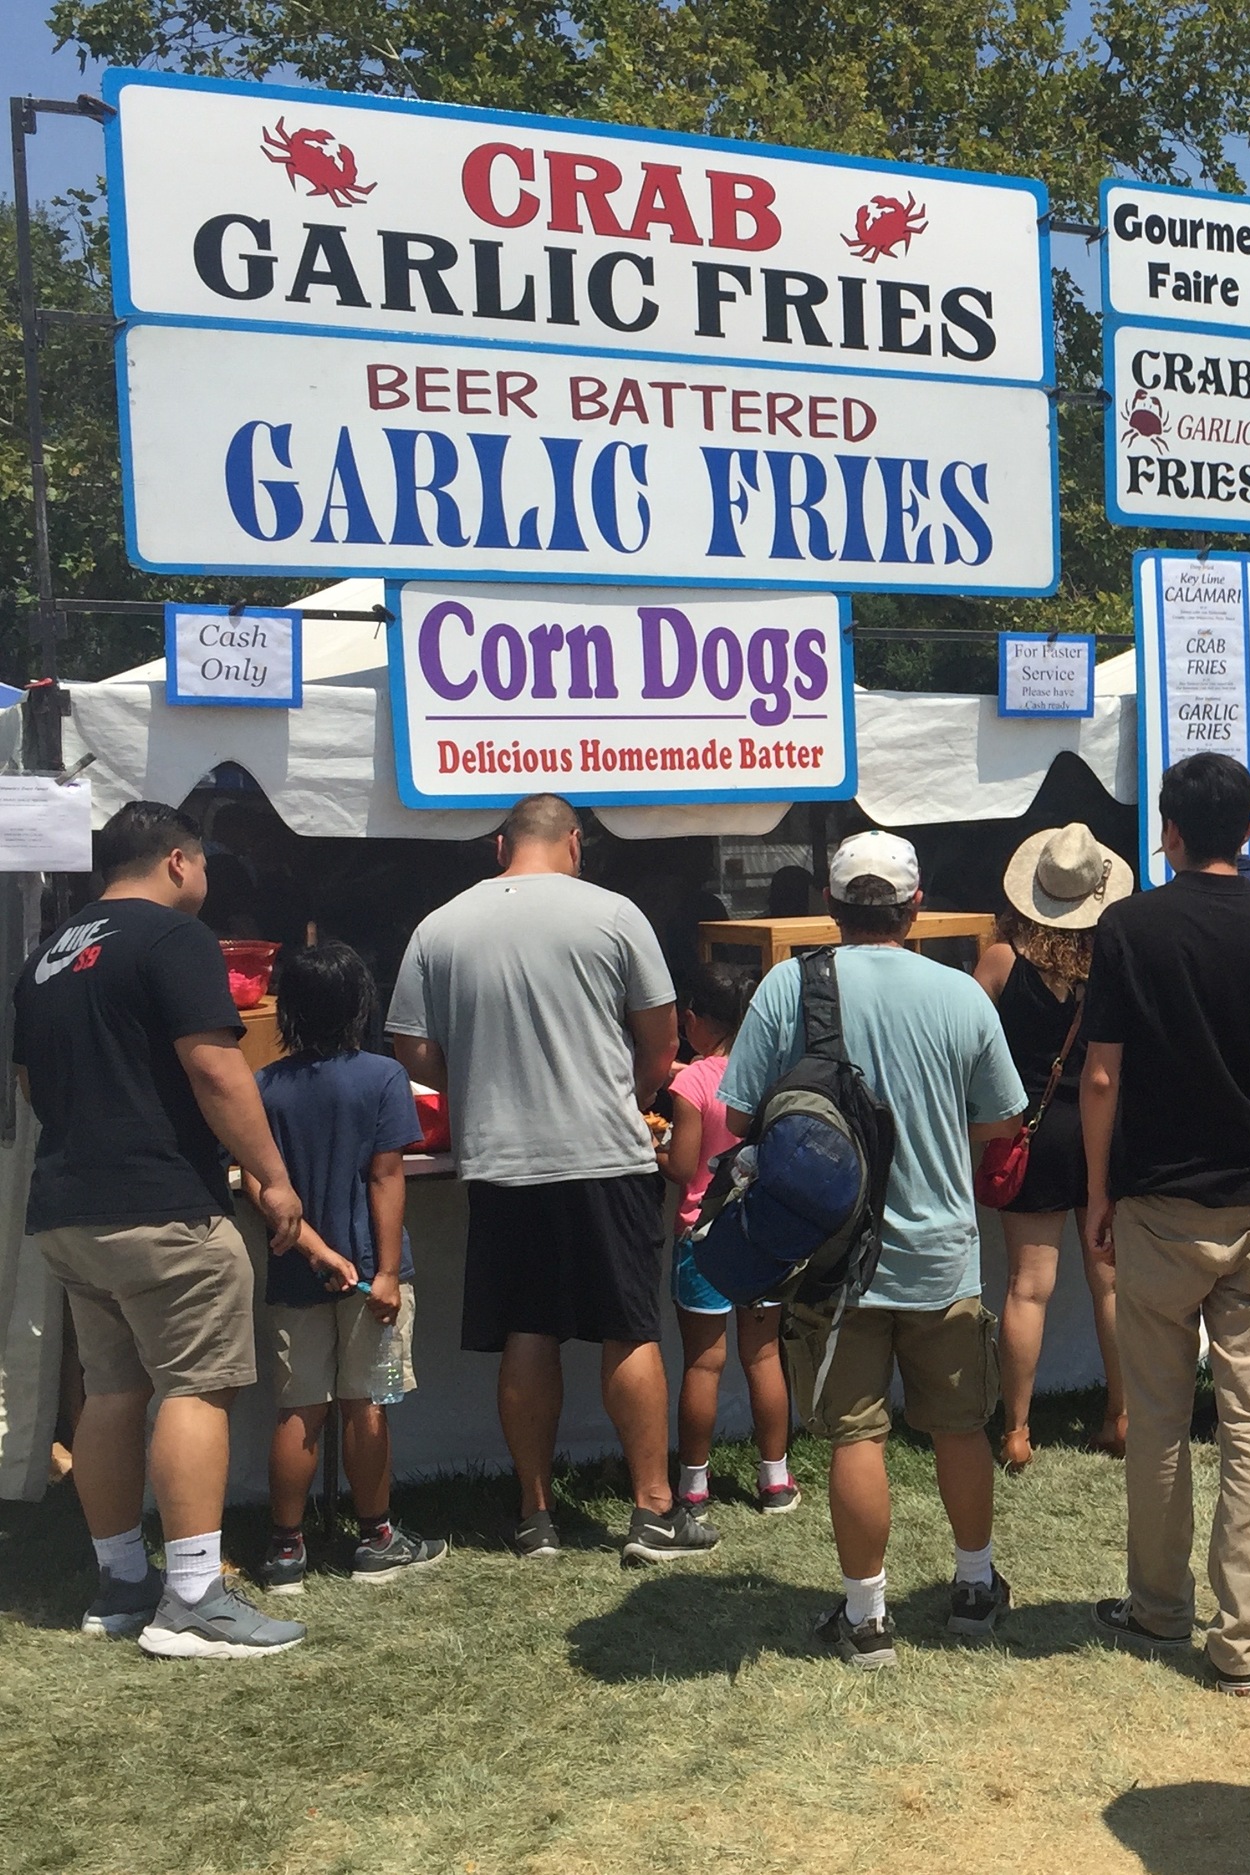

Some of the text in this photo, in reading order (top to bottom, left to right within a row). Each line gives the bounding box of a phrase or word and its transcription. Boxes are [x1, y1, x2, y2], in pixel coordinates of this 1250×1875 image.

[462, 142, 782, 252] CRAB
[193, 212, 997, 362] GARLIC FRIES
[1147, 261, 1240, 308] Faire
[367, 363, 878, 443] BEER BATTERED
[225, 420, 994, 567] GARLIC FRIES
[1180, 572, 1225, 586] Key Lime
[1164, 586, 1242, 604] CALAMARI
[199, 624, 268, 648] Cash
[1186, 637, 1226, 654] CRAB
[418, 600, 828, 726] Corn Dogs
[1014, 644, 1082, 659] For Faster
[201, 657, 267, 688] Only
[1022, 665, 1075, 681] Service
[1187, 659, 1227, 675] FRIES
[1022, 686, 1075, 697] Please have
[1178, 703, 1239, 721] GARLIC
[1186, 722, 1232, 741] FRIES
[437, 737, 824, 774] Delicious Homemade Batter
[50, 918, 110, 954] NIKE
